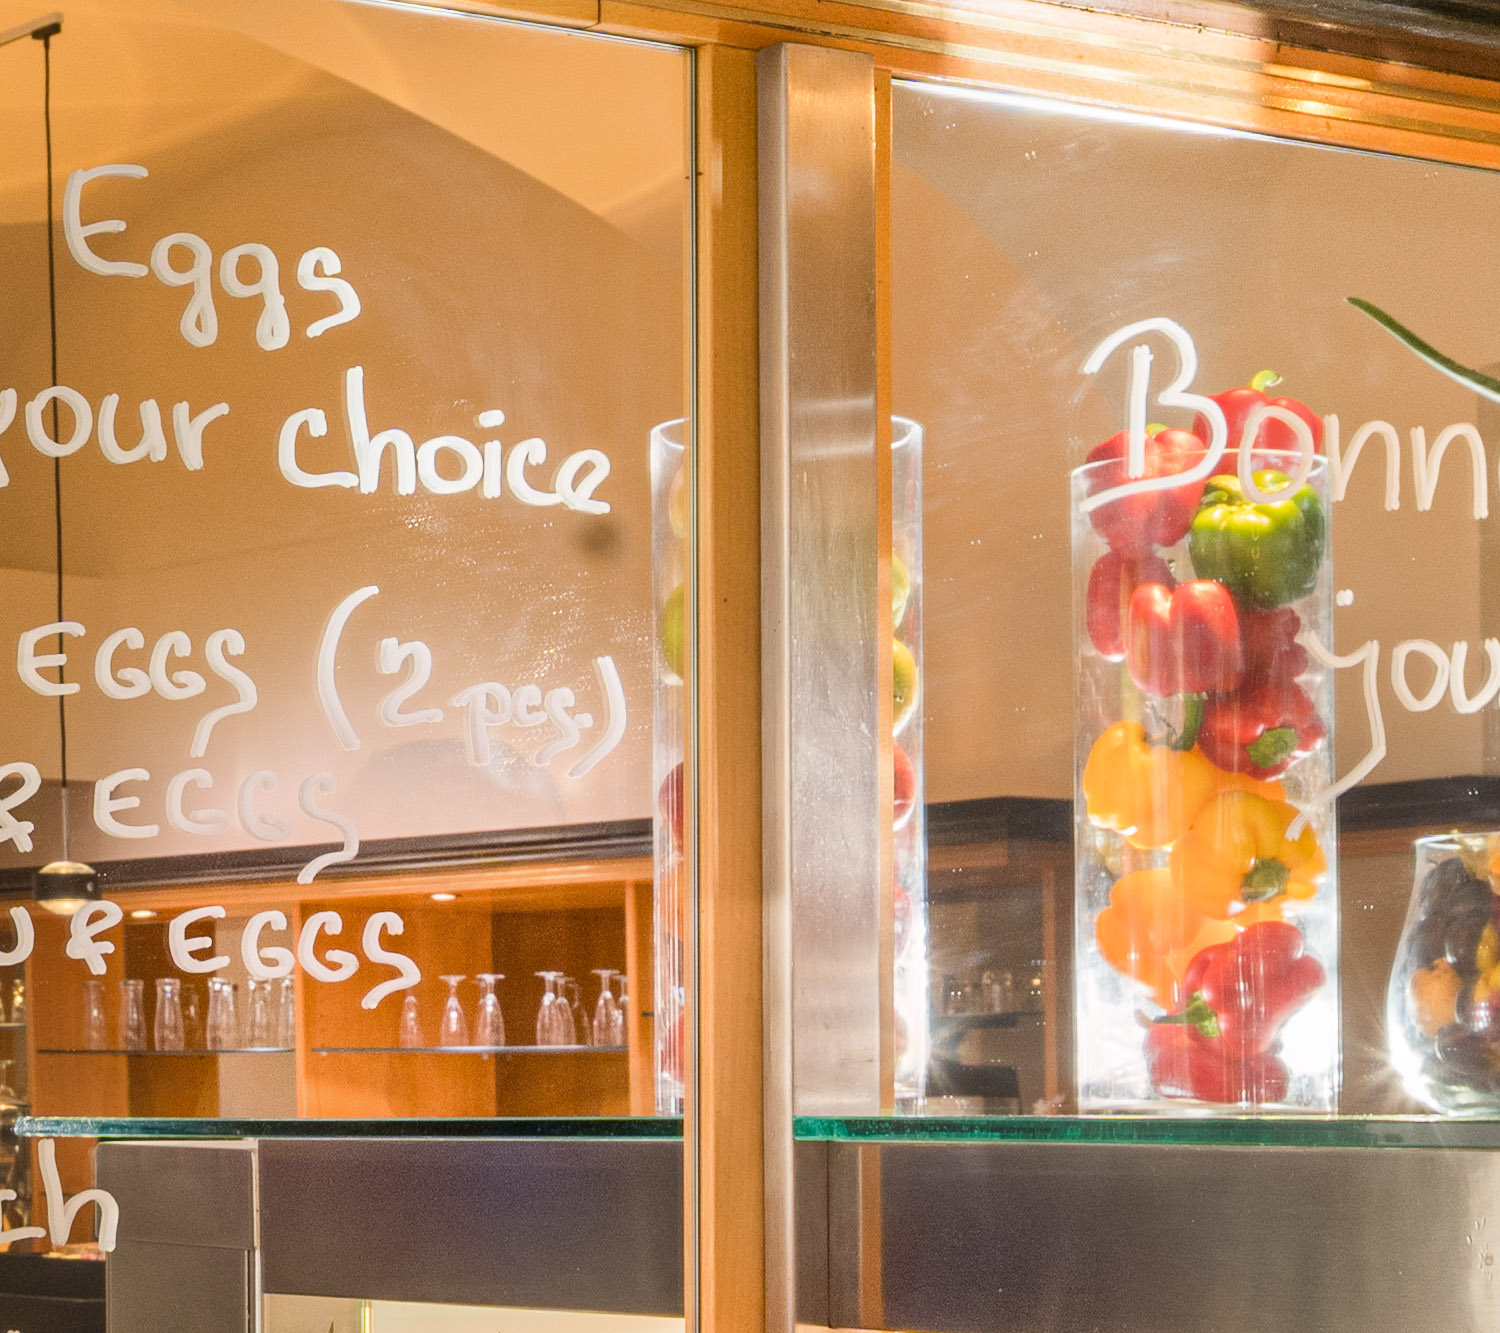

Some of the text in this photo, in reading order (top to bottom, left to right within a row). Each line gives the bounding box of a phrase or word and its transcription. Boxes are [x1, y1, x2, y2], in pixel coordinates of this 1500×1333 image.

[64, 163, 362, 351] Eggs
[278, 365, 611, 515] choice
[17, 620, 258, 756] EGGS
[93, 766, 361, 884] EGGS
[65, 898, 124, 975] &
[169, 904, 423, 1010] EGGS
